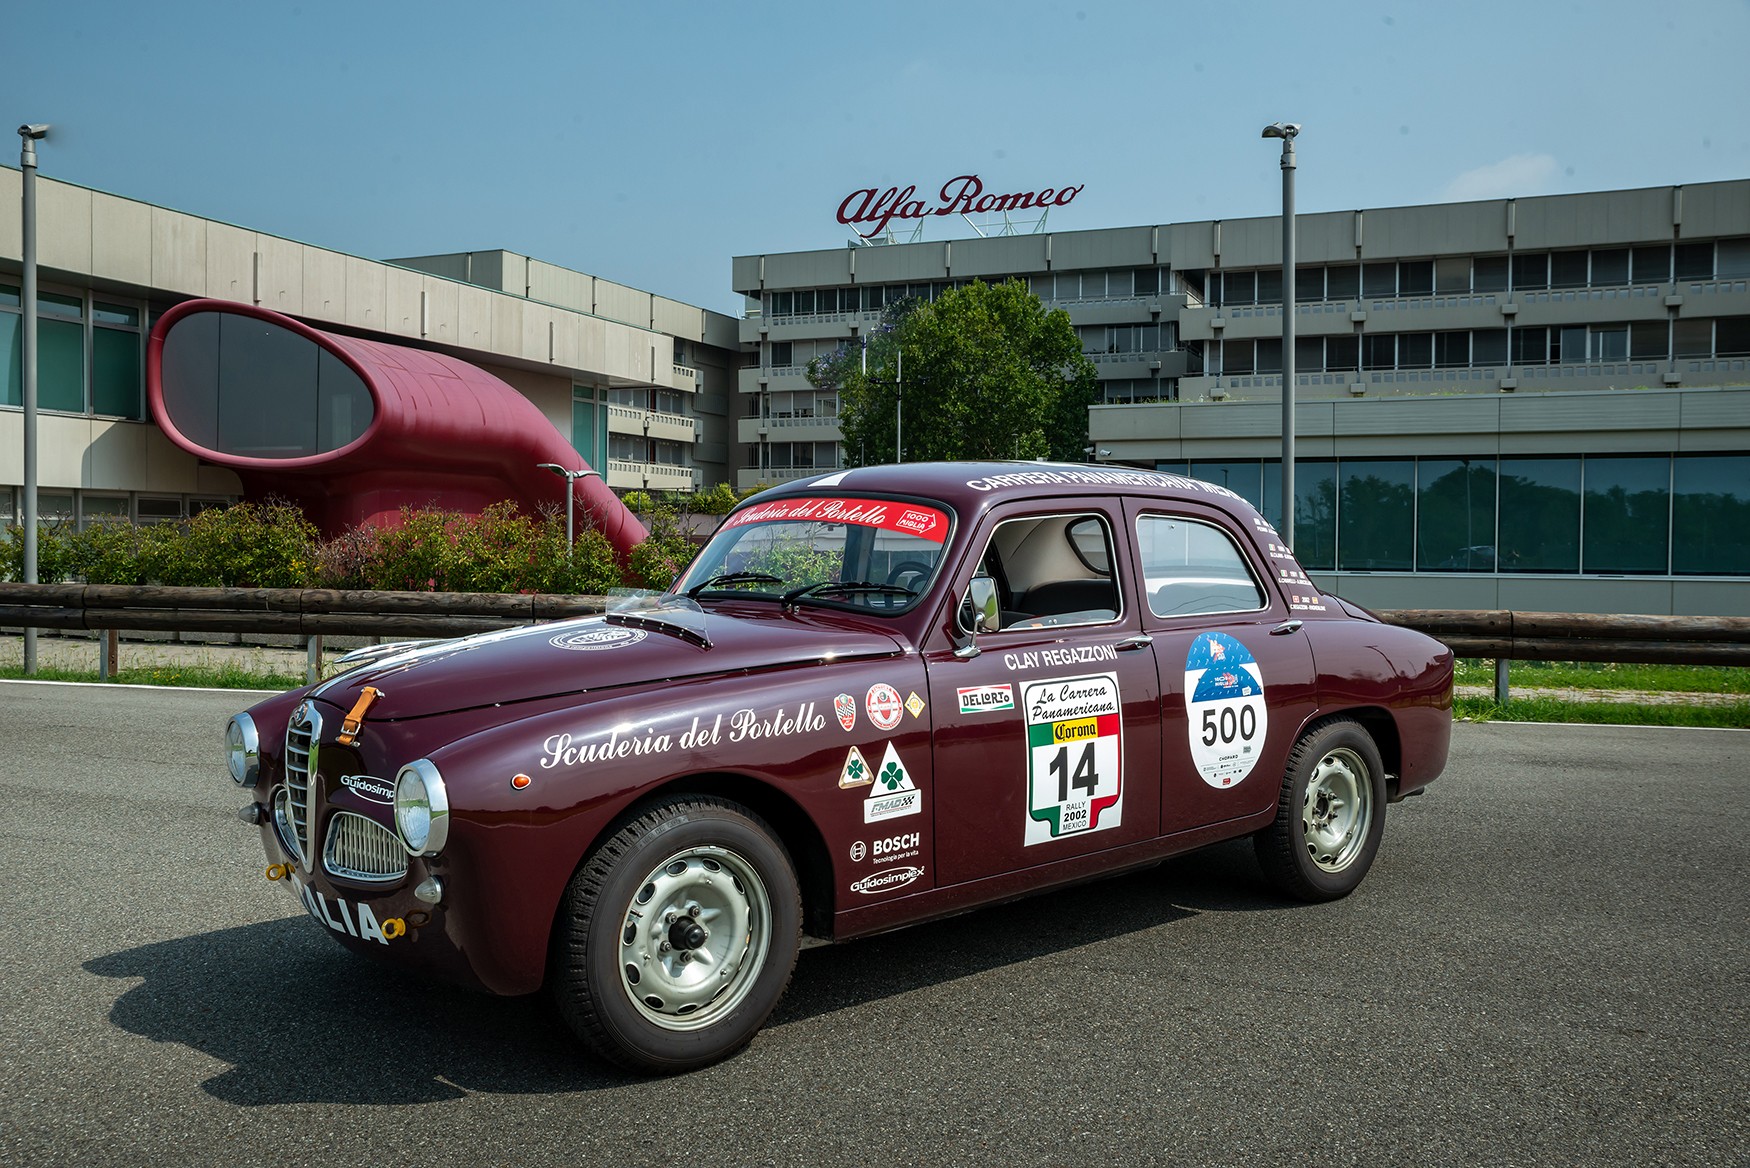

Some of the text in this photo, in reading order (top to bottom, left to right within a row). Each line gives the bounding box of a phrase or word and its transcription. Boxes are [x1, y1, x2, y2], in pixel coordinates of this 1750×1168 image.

[836, 174, 1085, 238] Alfa Romeo
[966, 471, 1065, 491] CARRERA
[733, 500, 887, 526] Scuderia del Portello
[906, 512, 929, 523] 1000
[899, 519, 925, 530] MIGLIA
[1004, 644, 1118, 671] CLAY REGAZZONI
[962, 691, 1010, 707] DELLORTO
[1036, 684, 1107, 705] La Carrera
[540, 727, 673, 769] Scuderia
[679, 714, 722, 750] del
[729, 702, 827, 742] Portello
[1054, 722, 1097, 742] Corona
[1202, 704, 1256, 747] 500
[1049, 742, 1099, 802] 14
[1063, 809, 1087, 822] 2002
[1066, 801, 1086, 811] RALLY
[1062, 820, 1087, 831] MEXICO
[873, 832, 920, 855] BOSCH
[873, 853, 898, 864] Tecnologia
[897, 852, 906, 860] per
[850, 866, 924, 892] Guidosimplex
